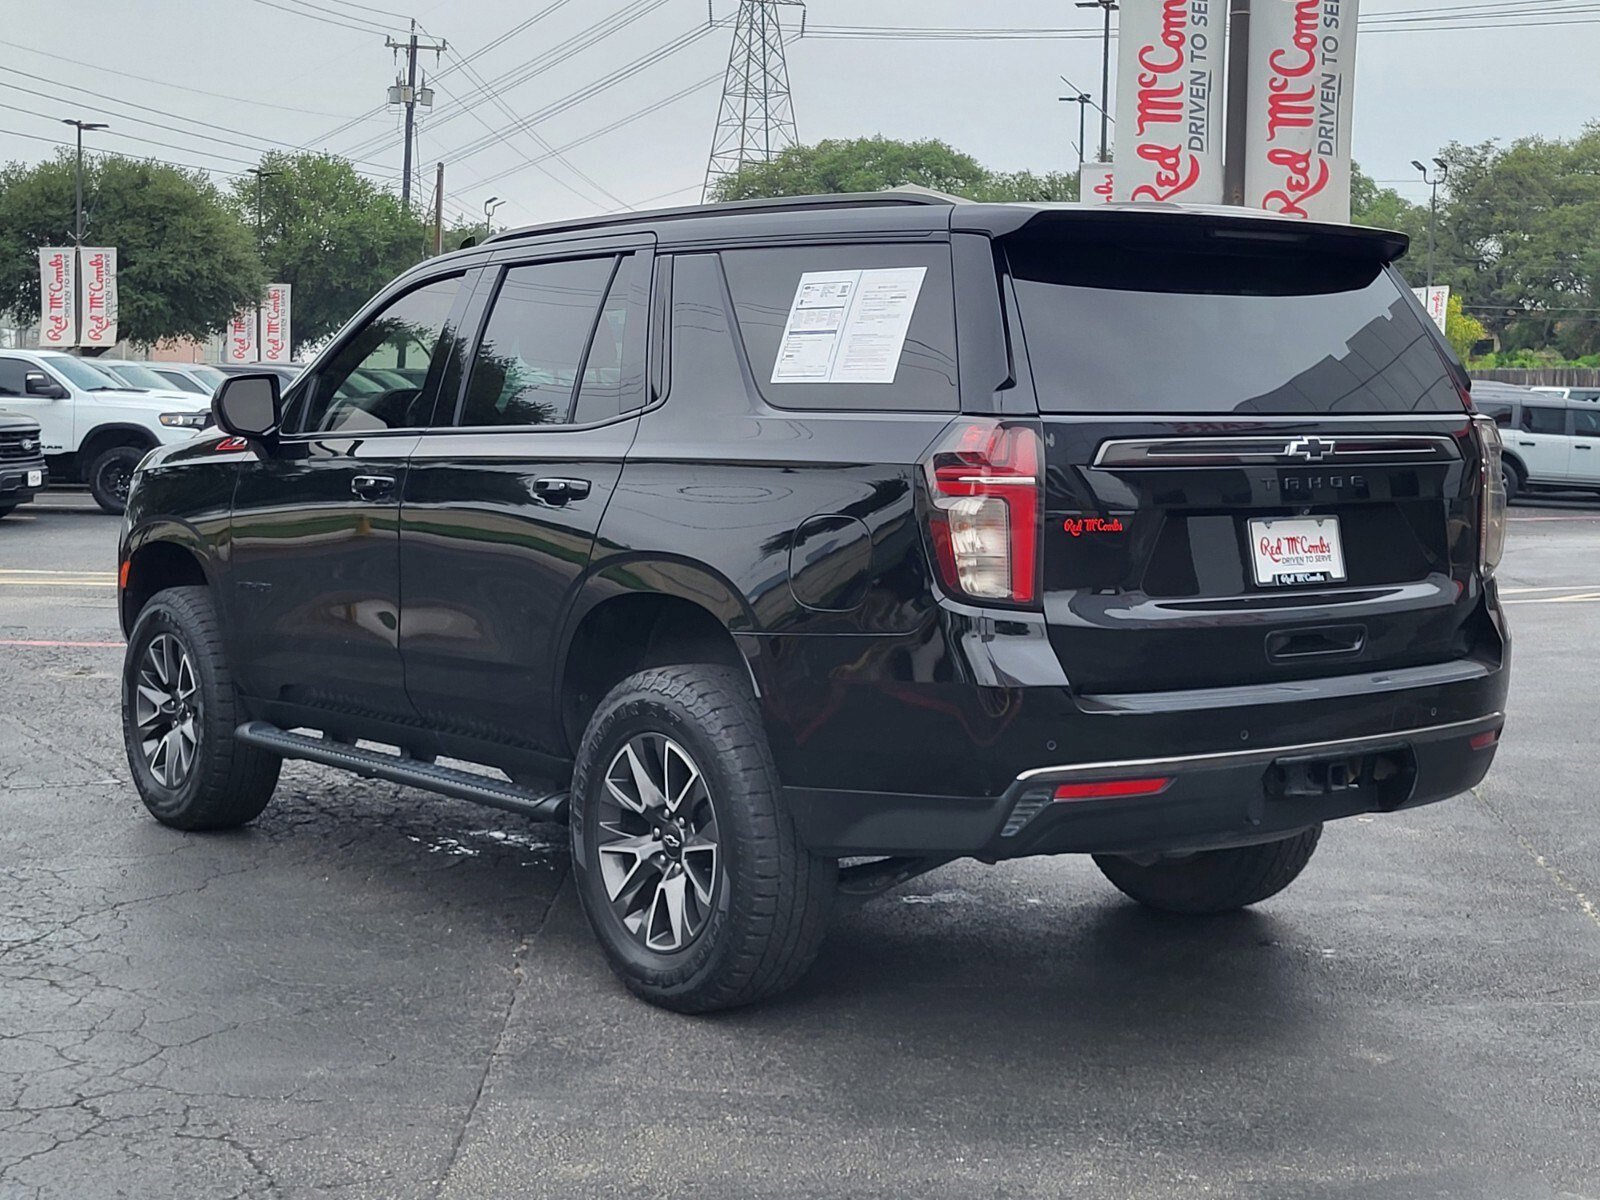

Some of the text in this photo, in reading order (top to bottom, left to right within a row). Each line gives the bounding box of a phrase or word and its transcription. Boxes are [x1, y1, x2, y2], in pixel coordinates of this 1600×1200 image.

[1190, 33, 1208, 62] TO
[1321, 36, 1339, 66] TO
[1188, 70, 1207, 152] DRIVEN
[1317, 73, 1336, 156] DRIVEN
[1131, 143, 1200, 201] Red
[1262, 148, 1330, 218] Red
[47, 253, 68, 341] Red McCombs
[64, 278, 70, 288] TO
[88, 253, 110, 341] Red McCombs
[105, 278, 111, 288] TO
[266, 289, 284, 359] Red McCombs
[233, 338, 250, 359] Red
[1260, 475, 1364, 490] TAHOE
[1064, 518, 1123, 537] Red McCombs
[1260, 536, 1331, 563] Red McCombs
[1281, 554, 1332, 565] DRIVEN TO SERVE
[1280, 573, 1295, 585] Red
